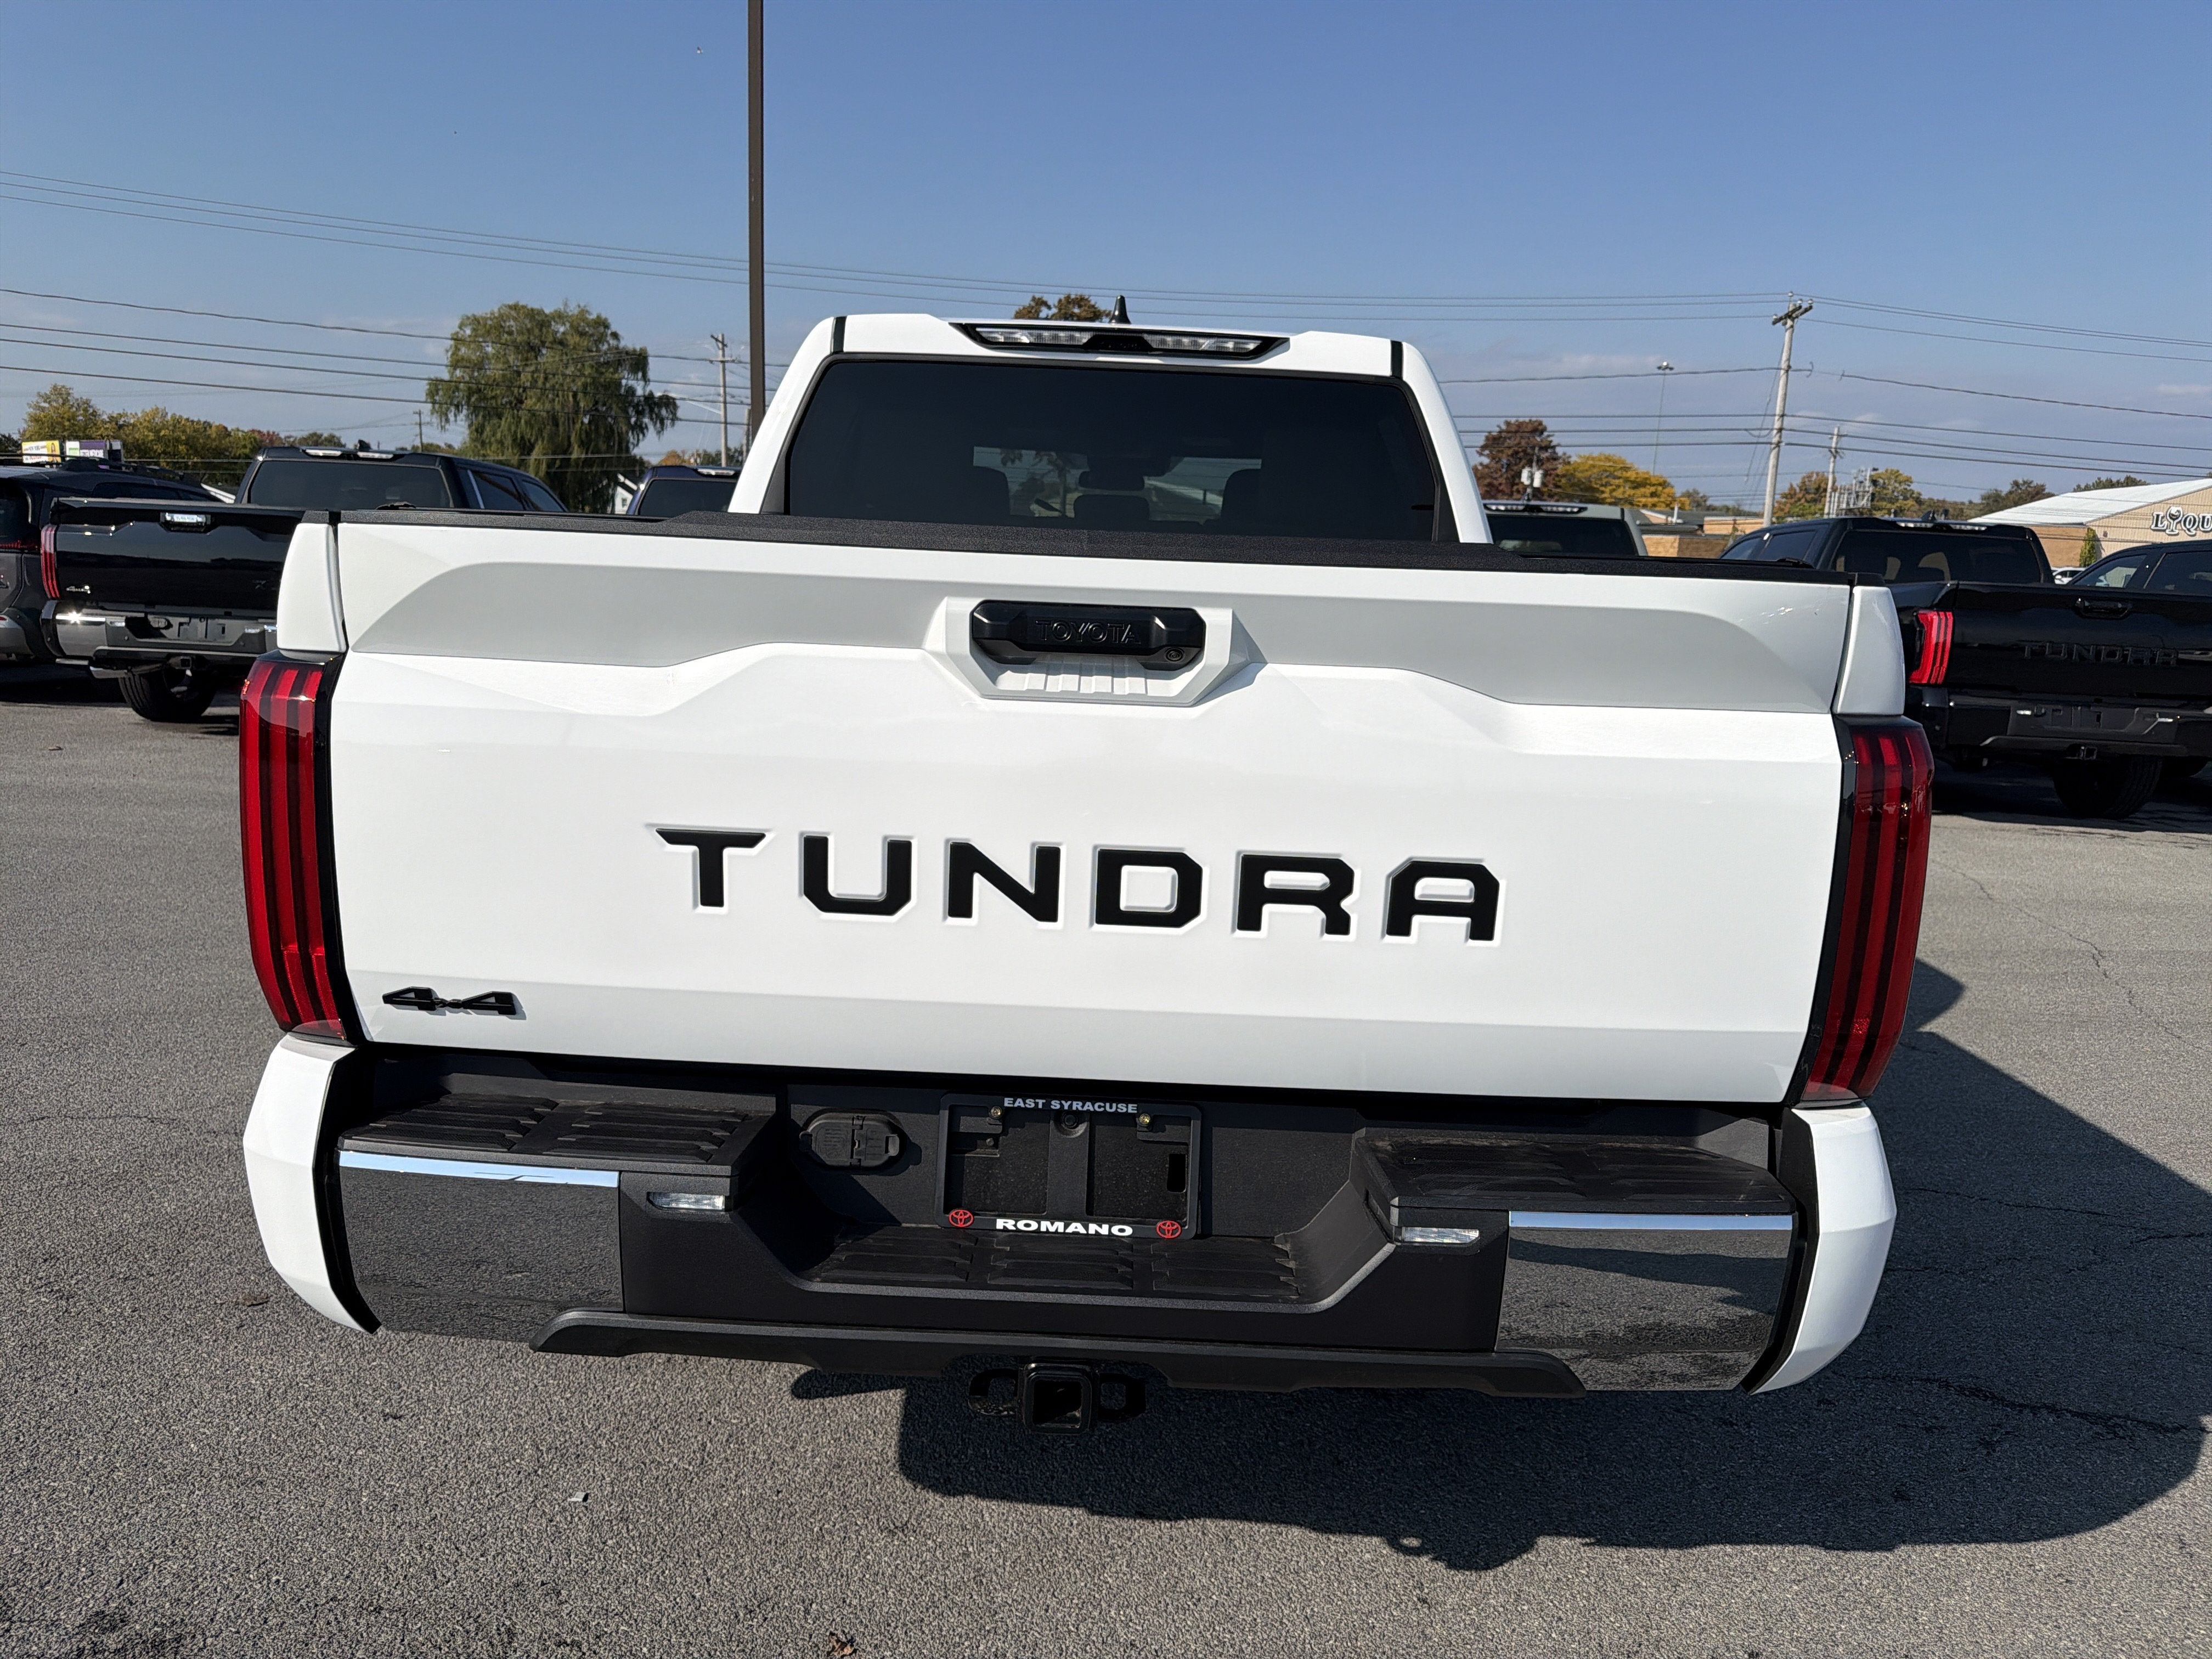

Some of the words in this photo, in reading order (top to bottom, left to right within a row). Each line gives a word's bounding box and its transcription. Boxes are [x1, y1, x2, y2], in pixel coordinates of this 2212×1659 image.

[1035, 619, 1142, 644] TOYOTA
[653, 827, 1501, 943] TUNDRA
[1003, 1097, 1046, 1109] EAST
[1050, 1099, 1138, 1114] SYRACUSE
[995, 1218, 1133, 1236] ROMANO
